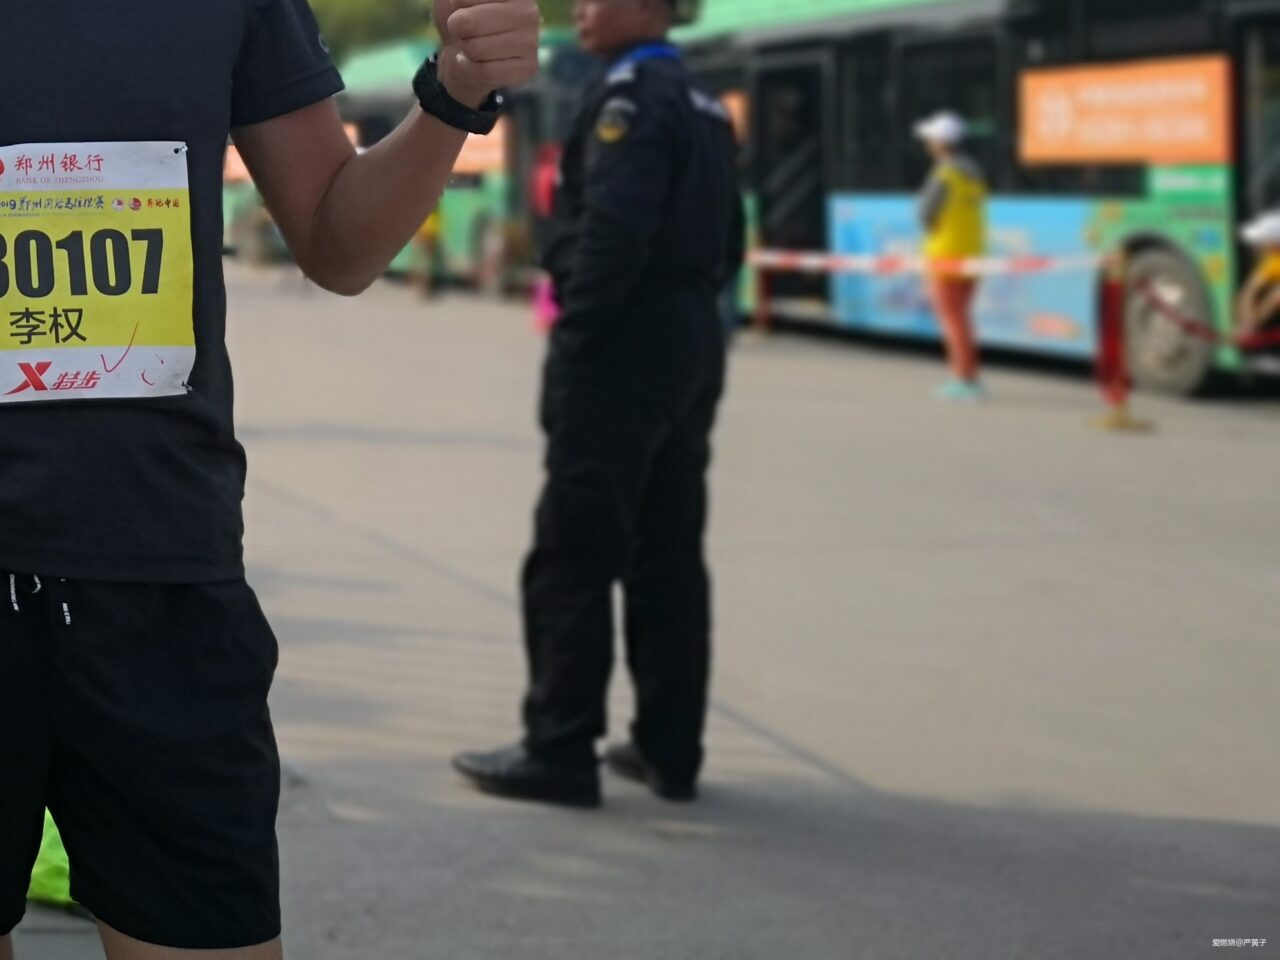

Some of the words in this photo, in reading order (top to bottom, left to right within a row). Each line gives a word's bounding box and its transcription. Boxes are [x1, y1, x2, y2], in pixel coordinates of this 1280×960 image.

[14, 153, 104, 175] 郑州银行
[54, 175, 104, 184] ZHENGZHOU
[9, 306, 87, 345] 李权
[50, 370, 101, 390] 特步
